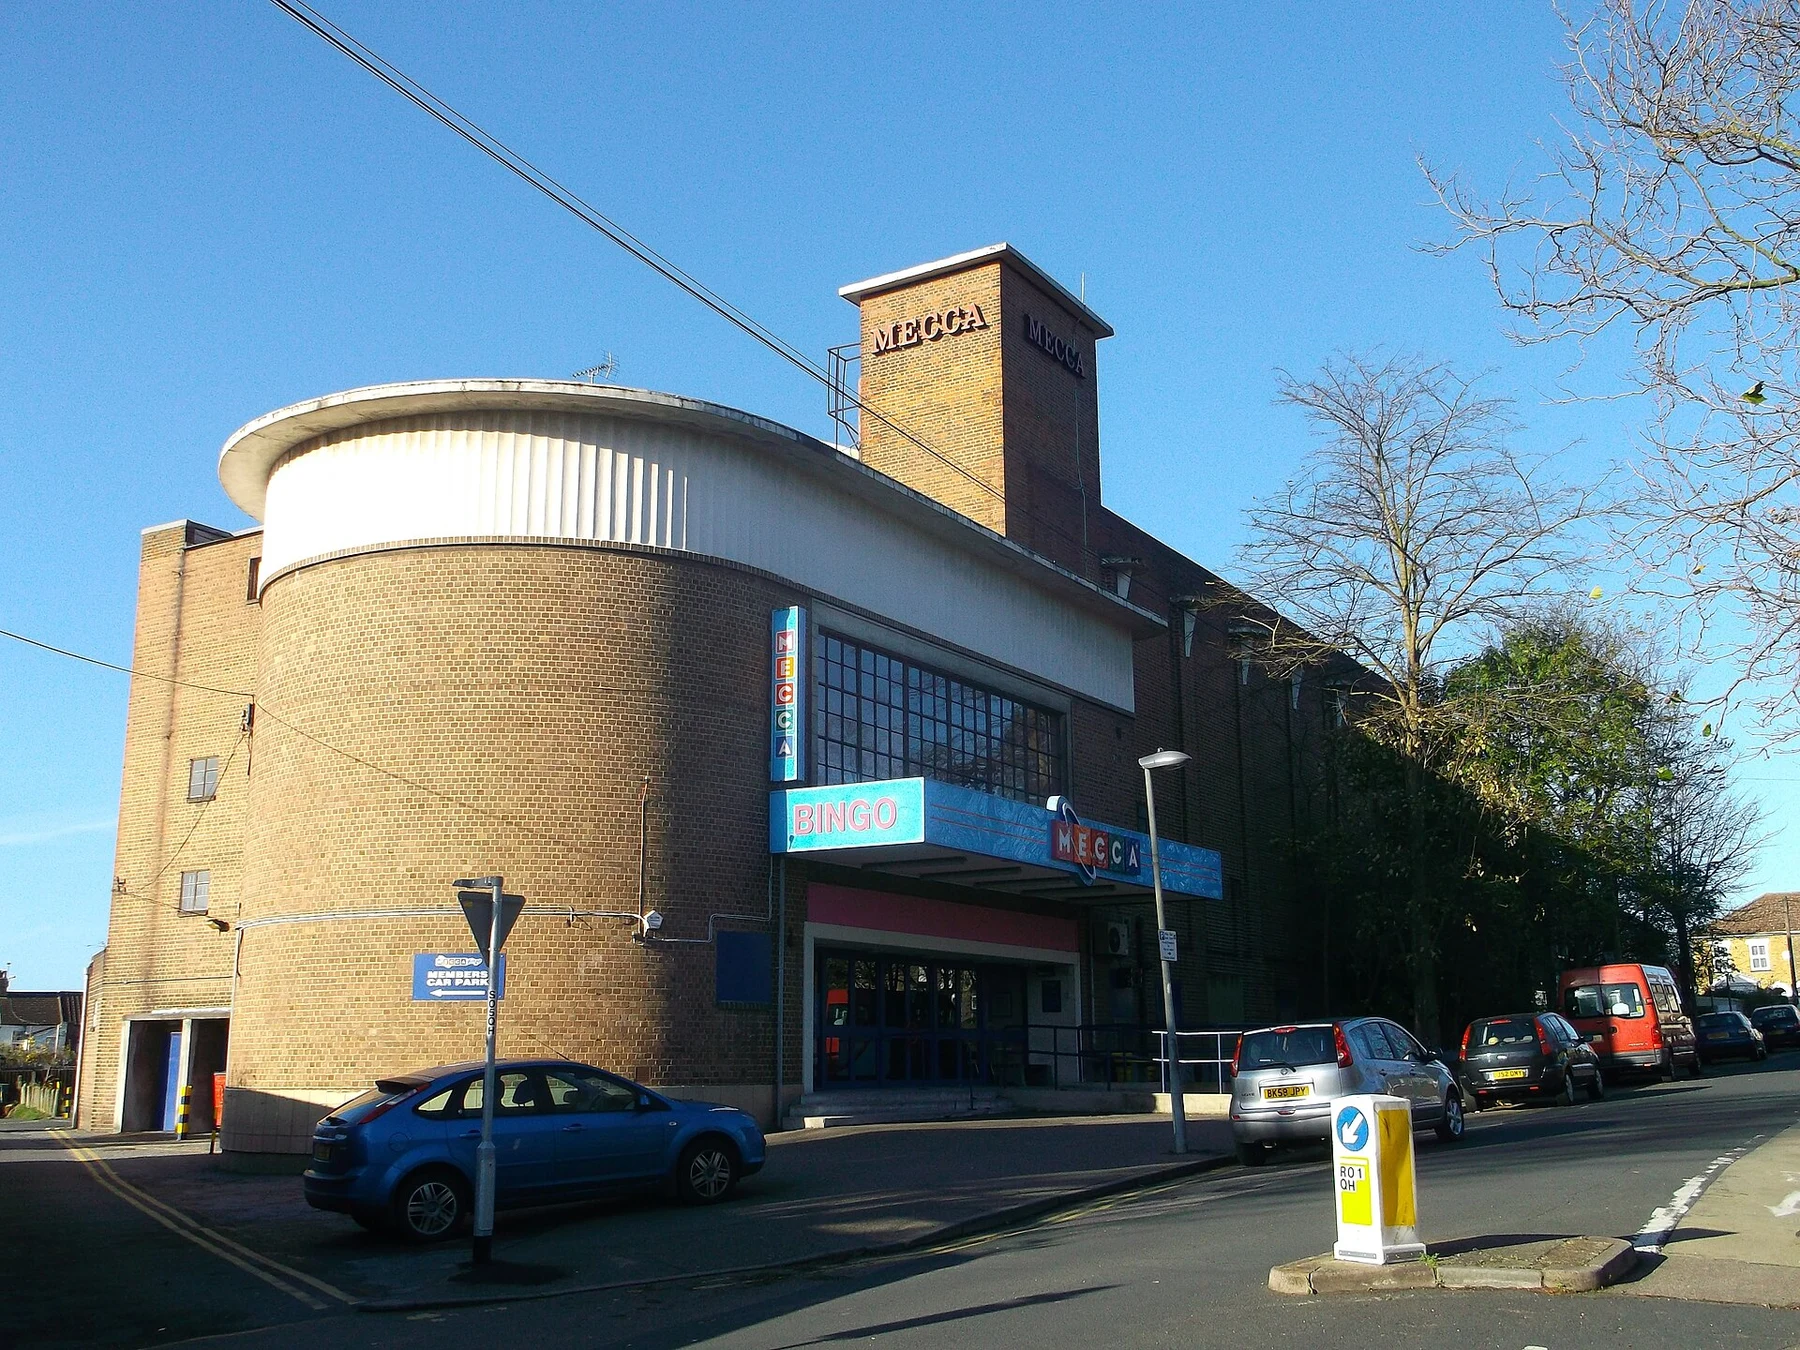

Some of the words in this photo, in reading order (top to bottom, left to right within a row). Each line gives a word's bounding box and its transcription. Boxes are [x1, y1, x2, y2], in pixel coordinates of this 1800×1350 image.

[871, 303, 988, 355] MECCA
[1025, 314, 1085, 377] MECCA
[776, 633, 794, 756] MECCA
[794, 797, 897, 835] BINGO
[1058, 828, 1138, 868] MECCA
[426, 978, 452, 986] CAR
[454, 978, 489, 986] PARK
[427, 971, 489, 979] MEMBERS
[1291, 1086, 1306, 1096] JPY
[1340, 1178, 1355, 1191] QH
